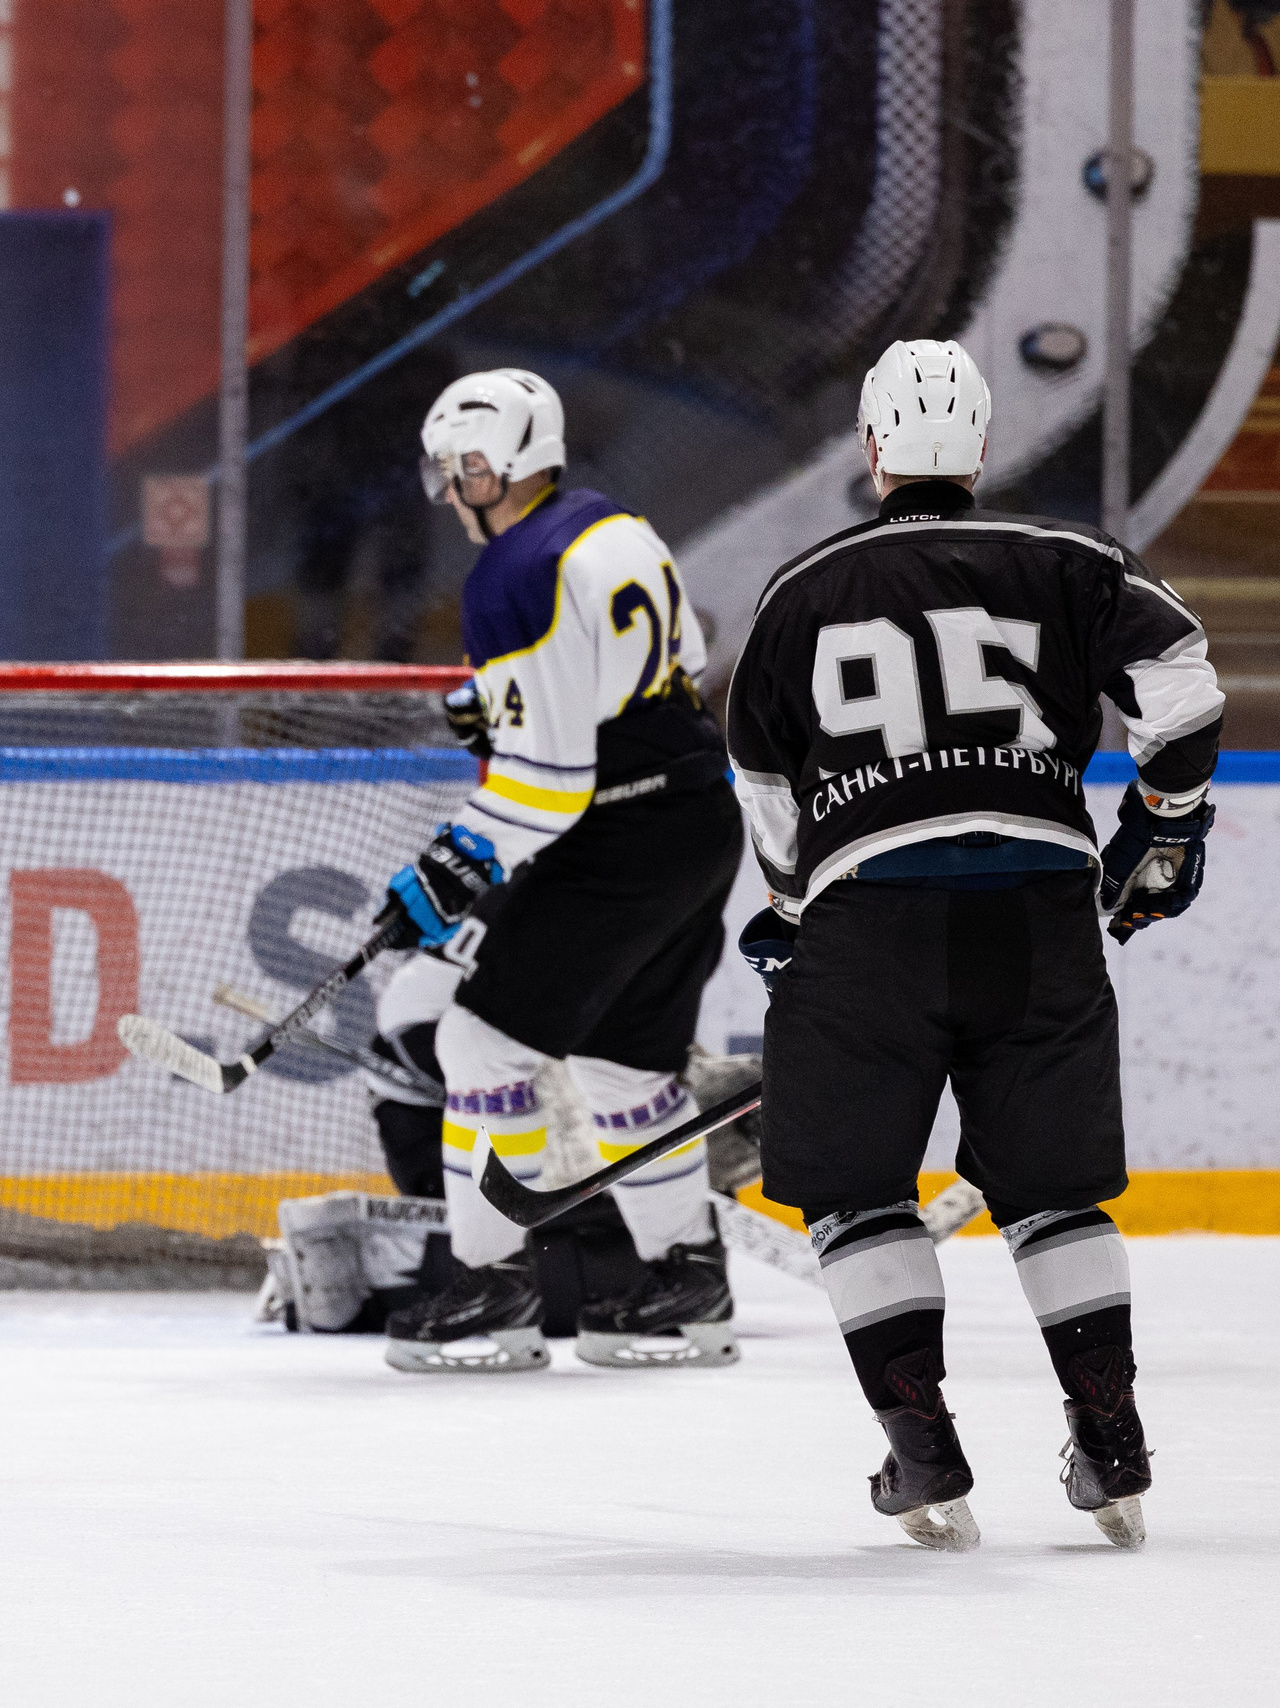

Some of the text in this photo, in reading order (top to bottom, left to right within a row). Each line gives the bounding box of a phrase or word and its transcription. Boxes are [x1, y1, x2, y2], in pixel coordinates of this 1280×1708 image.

[889, 514, 941, 523] LUTCH
[812, 606, 1058, 759] 95
[1153, 836, 1191, 844] CCM
